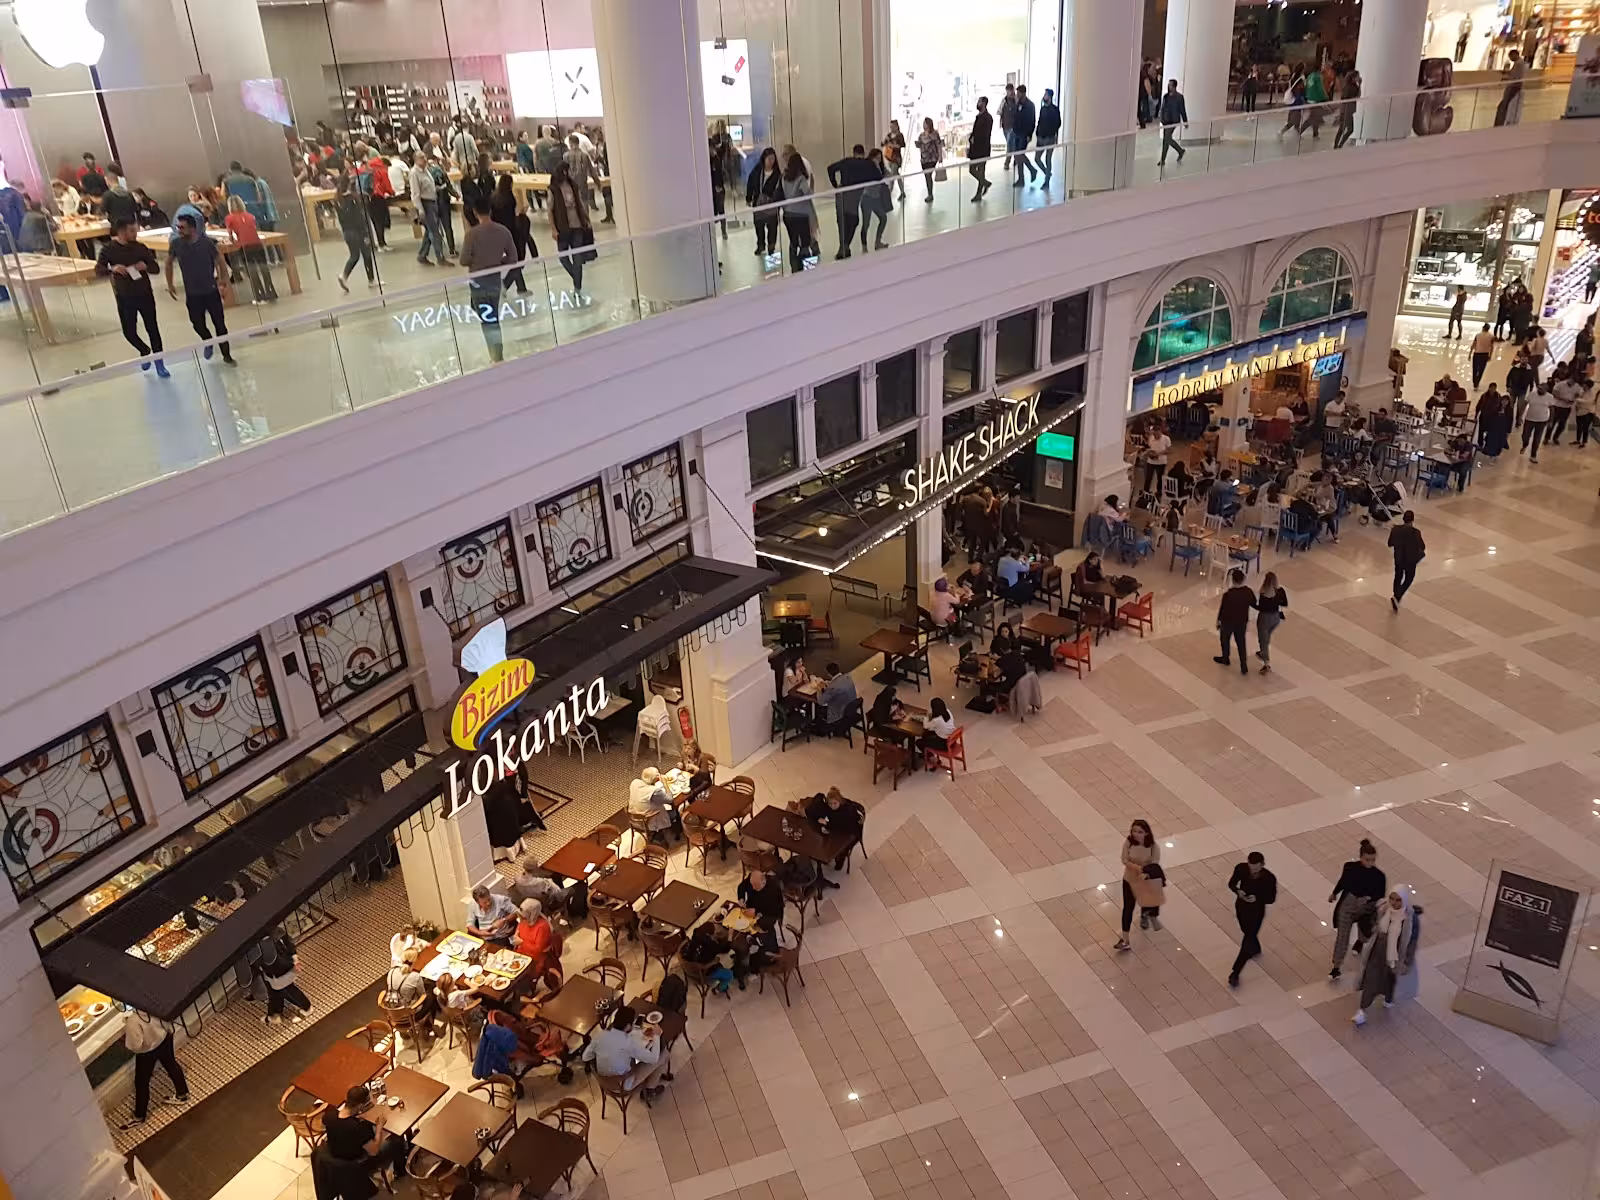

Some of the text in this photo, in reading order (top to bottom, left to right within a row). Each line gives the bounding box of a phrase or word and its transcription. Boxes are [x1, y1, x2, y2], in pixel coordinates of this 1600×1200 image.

[1157, 371, 1223, 409] BODRUM
[1286, 350, 1295, 367] &
[904, 391, 1041, 507] SHAKE SHACK
[458, 660, 530, 739] Bizim
[444, 676, 610, 819] Lokanta
[1503, 890, 1546, 911] FAZ.1
